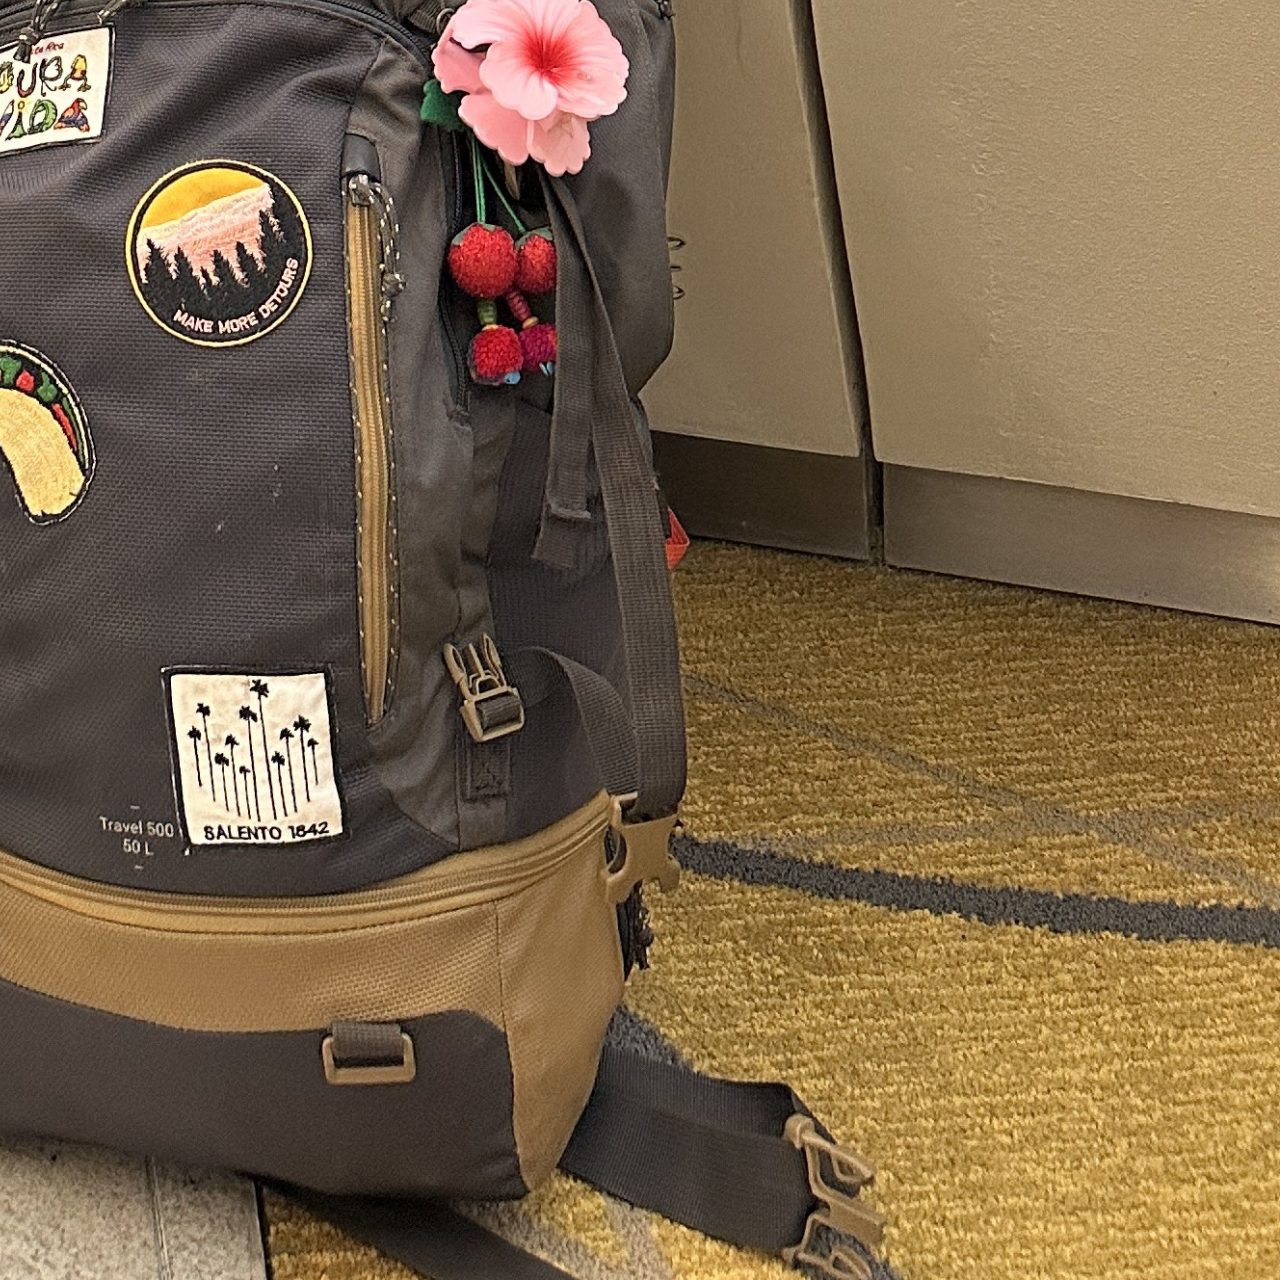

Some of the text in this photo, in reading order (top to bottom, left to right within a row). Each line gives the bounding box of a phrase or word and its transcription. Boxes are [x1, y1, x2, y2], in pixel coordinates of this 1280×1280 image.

[173, 257, 299, 334] MAKE MORE DETOURS
[99, 815, 175, 838] Travel 500
[204, 821, 330, 841] SALENTO 1842
[123, 838, 155, 857] 50 L
